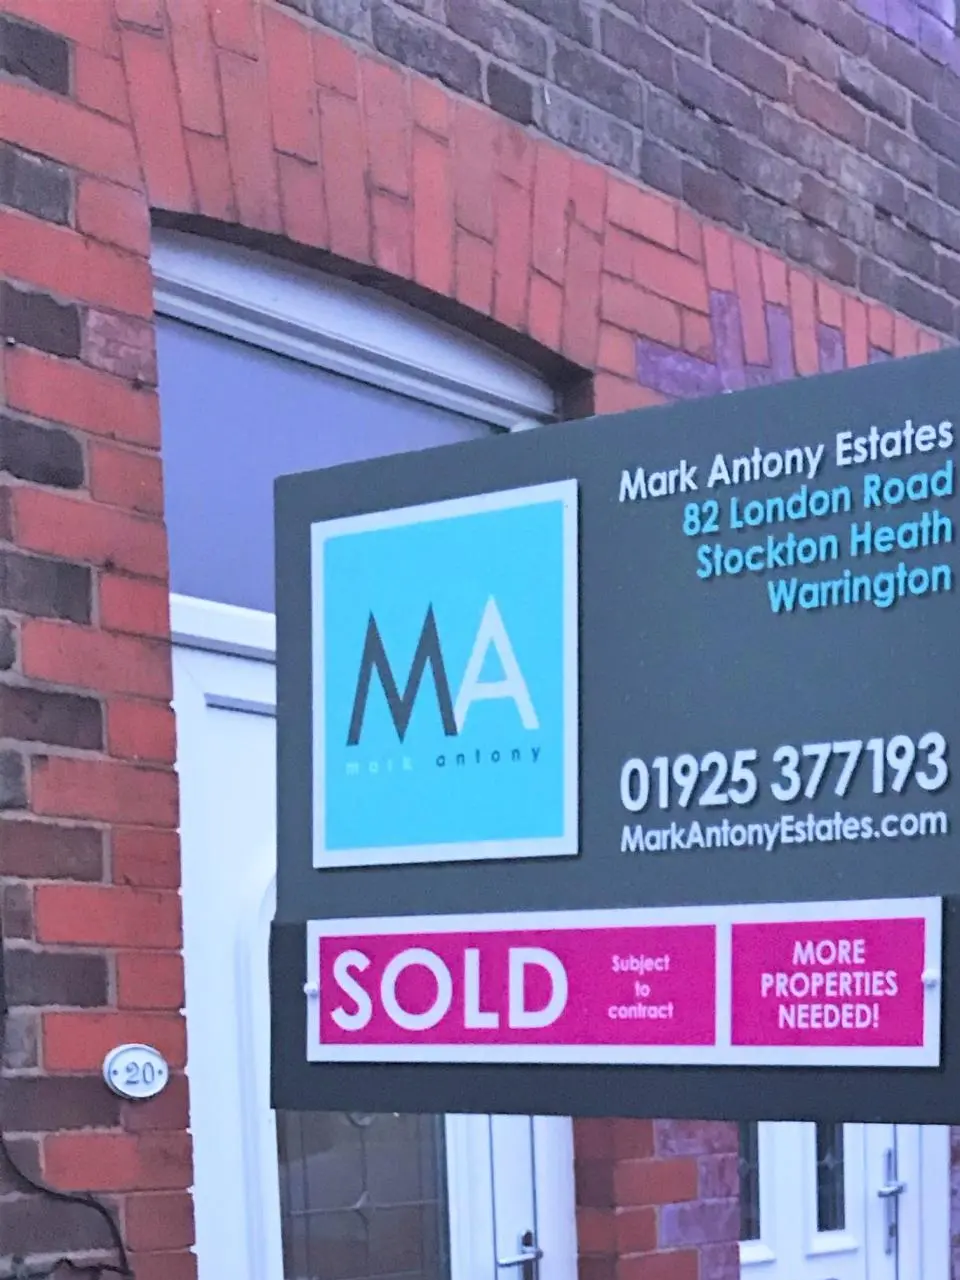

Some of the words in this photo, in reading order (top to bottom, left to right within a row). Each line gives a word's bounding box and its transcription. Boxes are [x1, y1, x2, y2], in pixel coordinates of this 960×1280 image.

[618, 460, 698, 503] Mark
[706, 443, 824, 489] Antony
[835, 419, 953, 468] Estates
[682, 499, 720, 536] 82
[729, 485, 851, 530] London
[863, 459, 953, 509] Road
[696, 532, 838, 580] Stockton
[850, 509, 952, 557] Heath
[767, 562, 951, 613] Warrington
[346, 592, 541, 747] MA
[436, 747, 541, 767] antony
[620, 748, 757, 812] 01925
[770, 731, 948, 801] 377193
[620, 810, 947, 853] MarkAntonyEstates.com
[611, 954, 671, 976] Subject
[792, 938, 866, 966] MORE
[330, 946, 568, 1031] SOLD
[634, 980, 651, 998] to
[761, 970, 898, 998] PROPERTIES
[607, 1001, 674, 1020] contract
[778, 1003, 879, 1029] NEEDED!
[125, 1061, 155, 1085] 20
